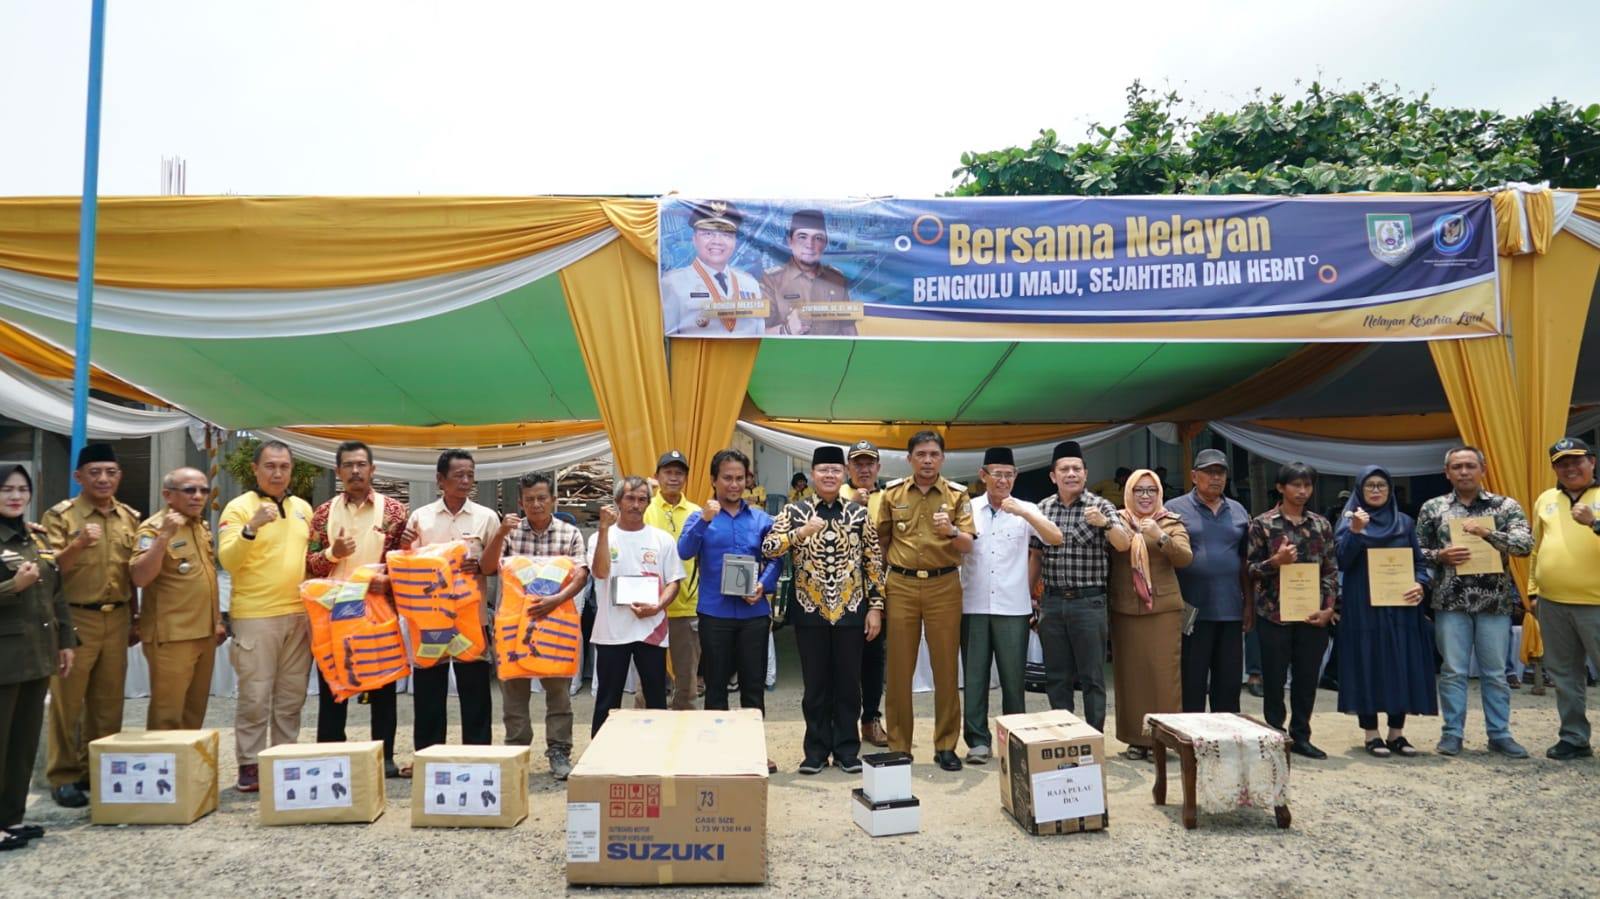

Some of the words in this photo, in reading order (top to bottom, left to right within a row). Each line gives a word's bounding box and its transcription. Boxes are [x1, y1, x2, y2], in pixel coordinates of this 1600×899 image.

[949, 222, 1114, 266] Bersama
[1126, 214, 1271, 259] Nelayan
[913, 272, 1013, 303] BENGKULU
[1019, 269, 1083, 297] MAJU,
[1089, 262, 1197, 293] SEJAHTERA
[1203, 260, 1242, 286] DAN
[1247, 256, 1305, 283] HEBAT
[1363, 314, 1405, 330] Nelayan
[701, 791, 714, 807] 73
[695, 816, 716, 824] CASE
[719, 816, 735, 824] SIZE
[607, 843, 724, 860] SUZUKI
